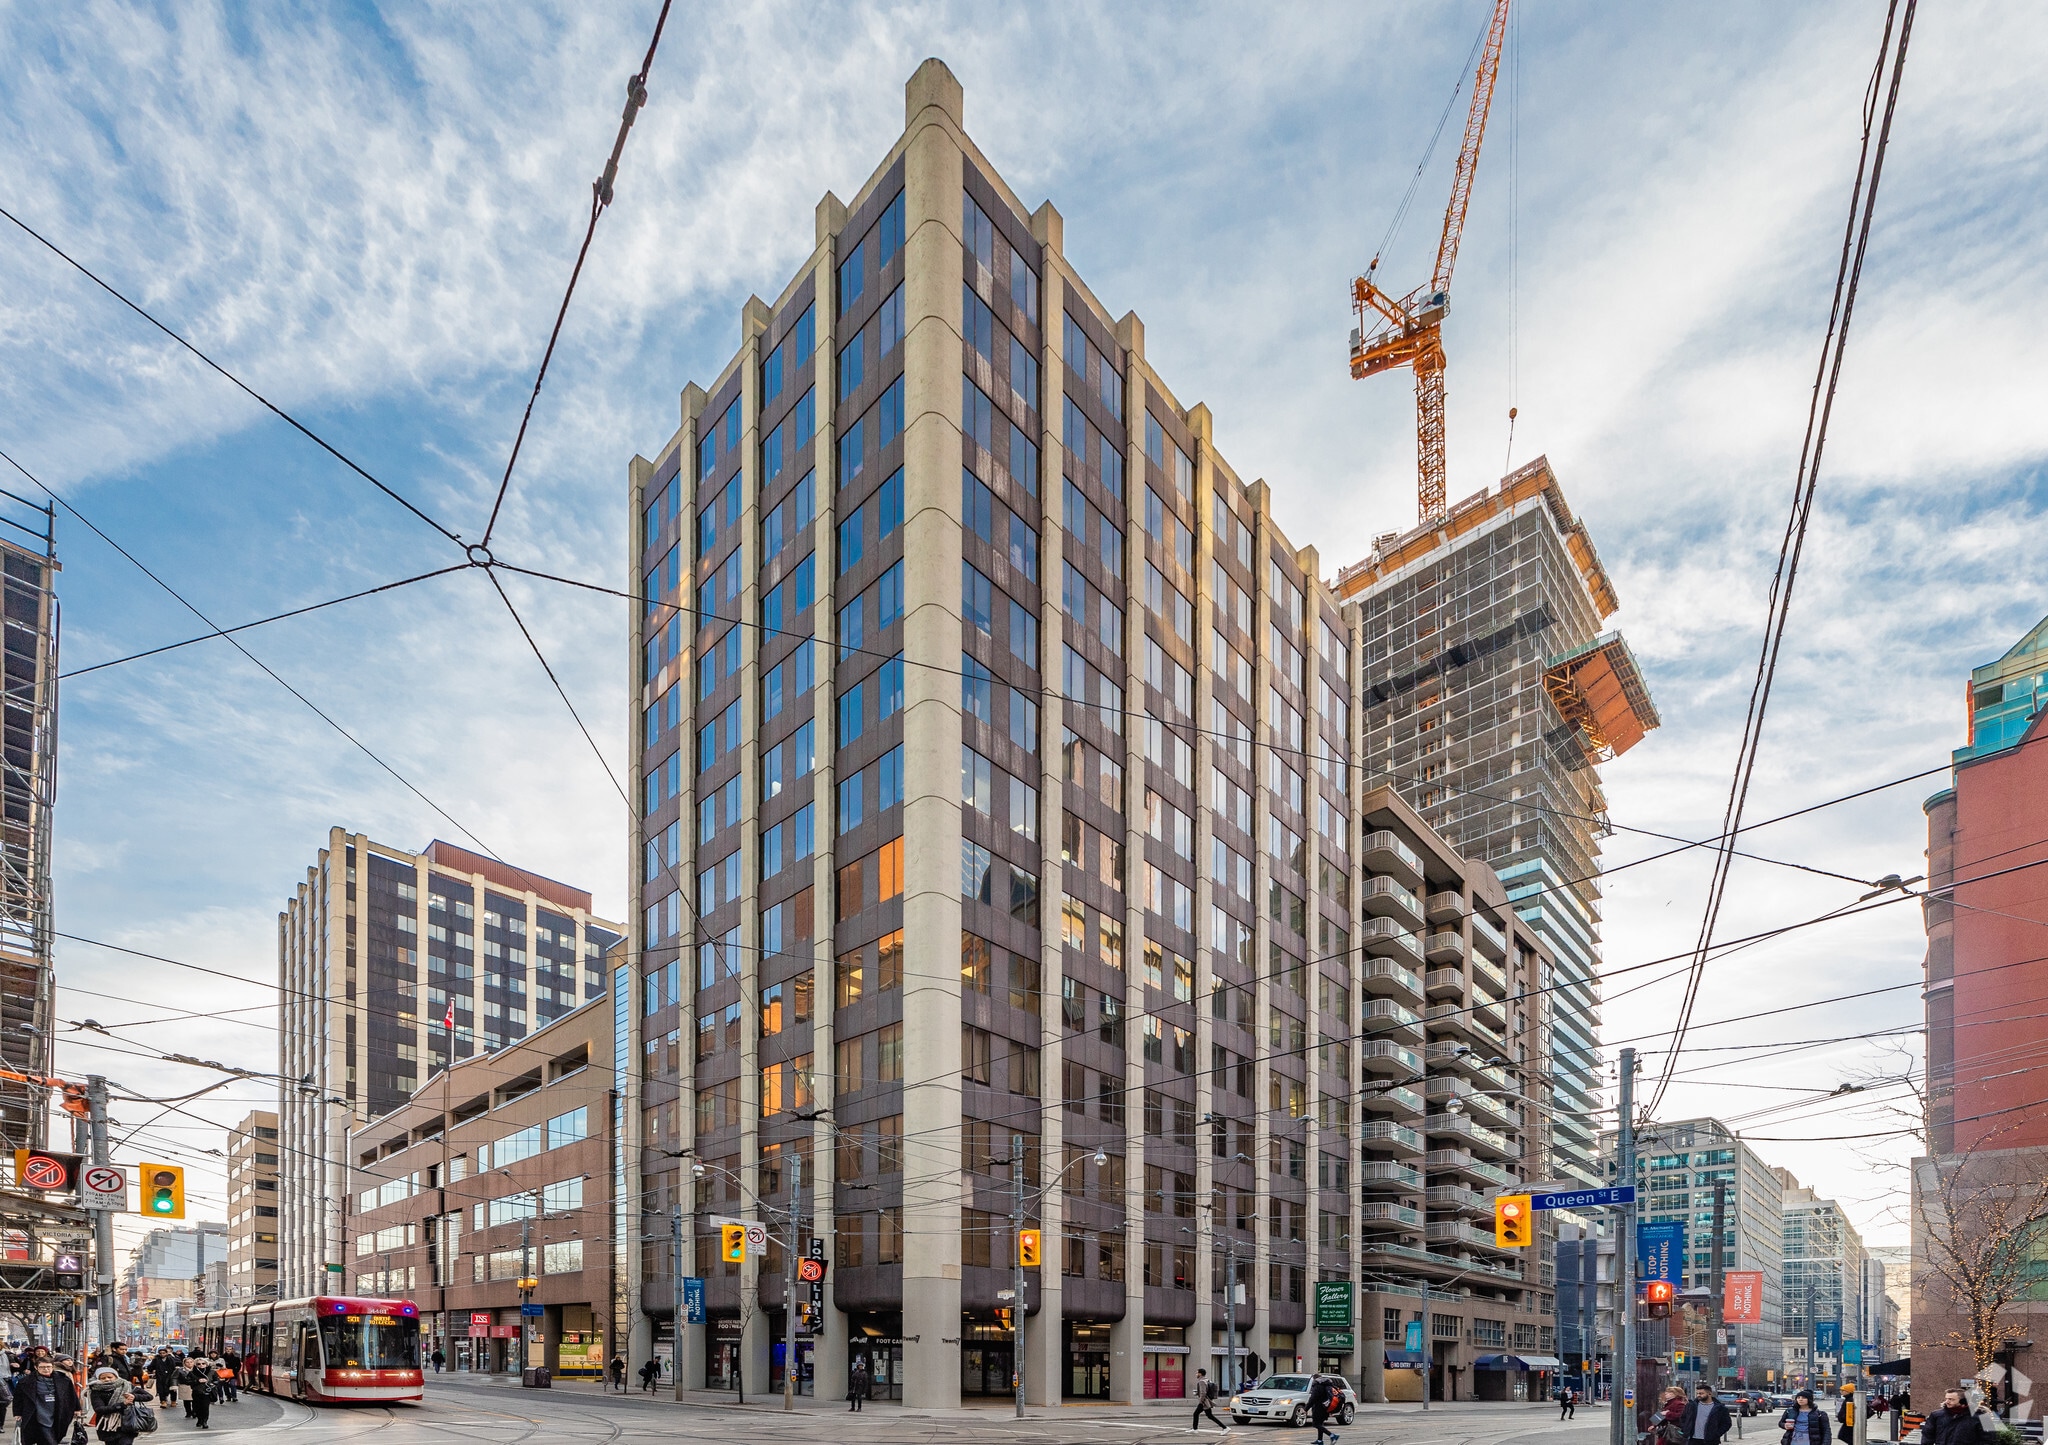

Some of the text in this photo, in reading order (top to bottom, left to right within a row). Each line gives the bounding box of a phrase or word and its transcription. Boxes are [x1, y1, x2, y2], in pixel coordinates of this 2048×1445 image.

[1545, 1194, 1595, 1207] Queen
[1610, 1189, 1620, 1201] E
[1648, 1245, 1657, 1275] STOP AT
[1319, 1286, 1345, 1295] Flower
[1320, 1293, 1349, 1304] Gallery
[1734, 1287, 1742, 1310] STOP AT
